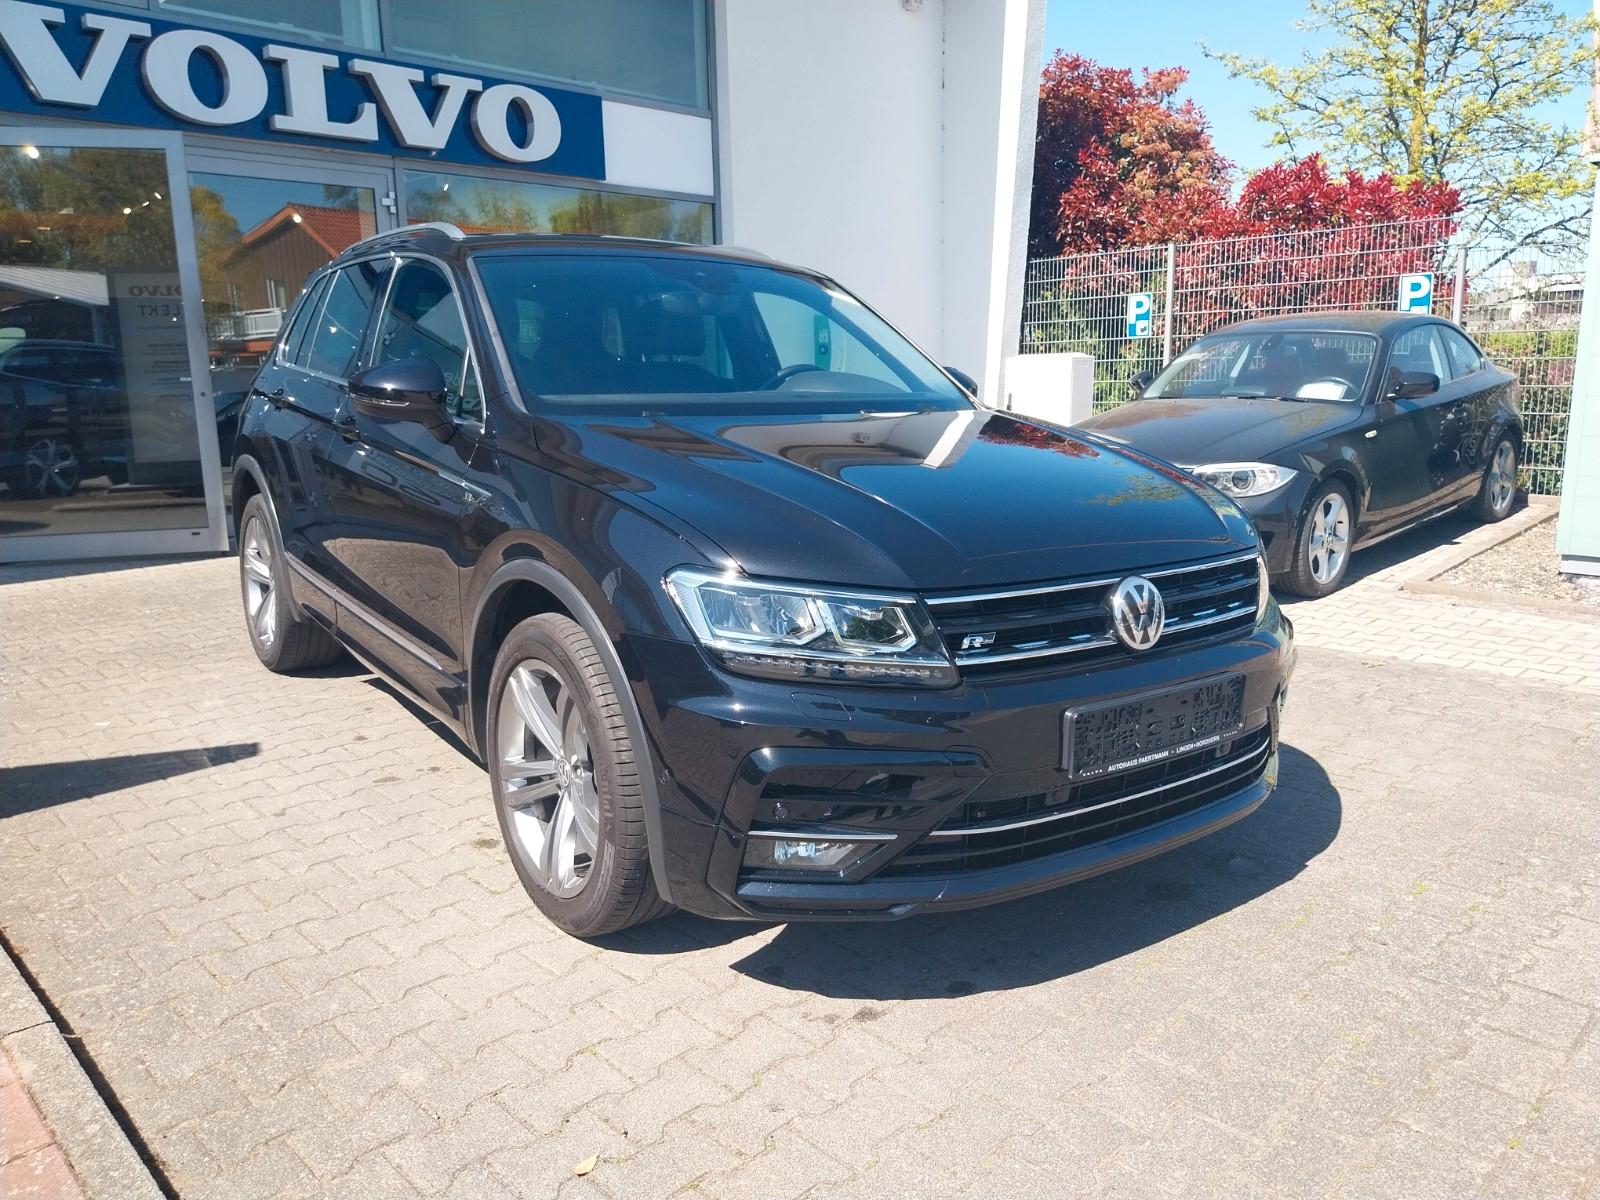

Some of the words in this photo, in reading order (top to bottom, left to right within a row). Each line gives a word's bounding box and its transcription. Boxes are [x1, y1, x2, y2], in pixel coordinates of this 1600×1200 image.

[0, 0, 562, 163] VOLVO
[1129, 295, 1150, 324] P
[1400, 275, 1431, 311] P
[588, 716, 615, 818] Coental
[1107, 758, 1138, 772] AUTOHAUS
